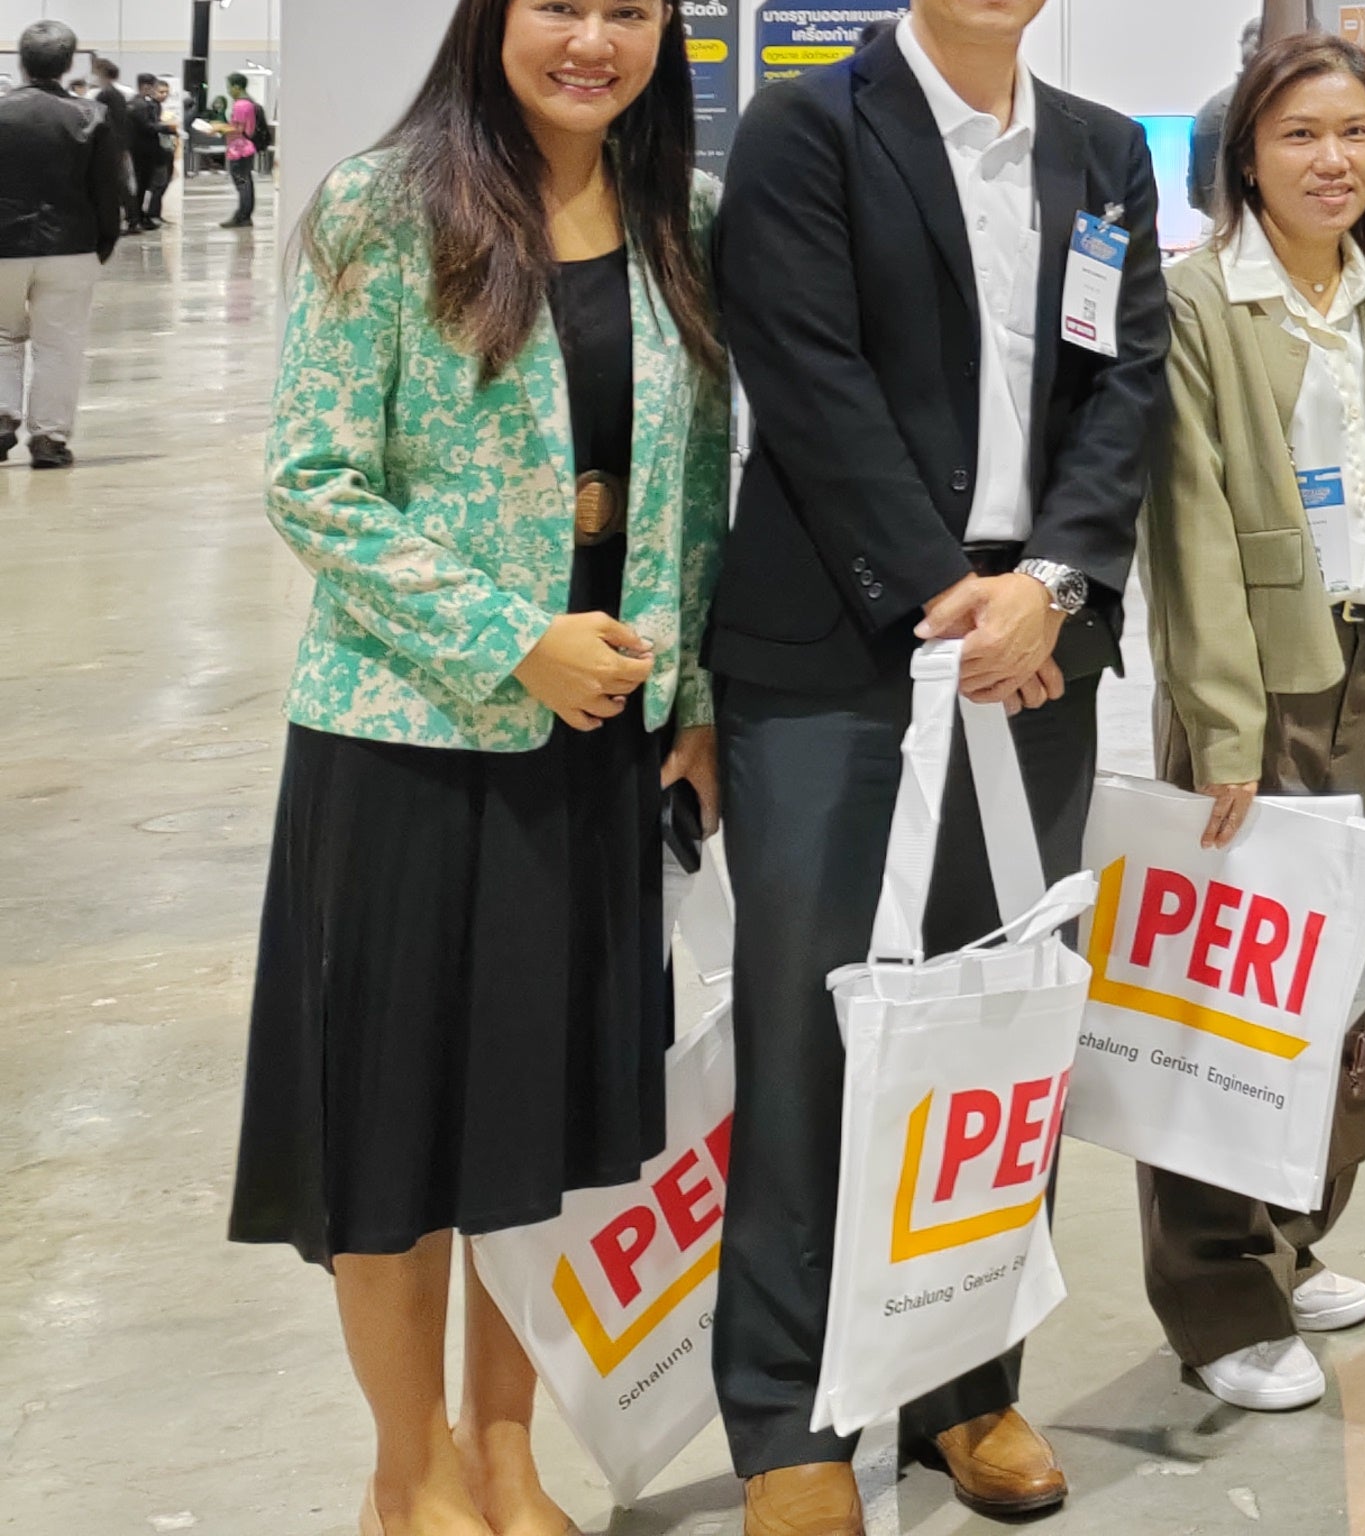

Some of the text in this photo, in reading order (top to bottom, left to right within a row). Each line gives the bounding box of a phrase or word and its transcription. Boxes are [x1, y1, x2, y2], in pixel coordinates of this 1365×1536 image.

[1129, 867, 1328, 1016] PERI
[1077, 1032, 1286, 1110] chalung Gerüst Engineering
[883, 1285, 955, 1317] Schalung
[617, 1335, 695, 1411] Schalung
